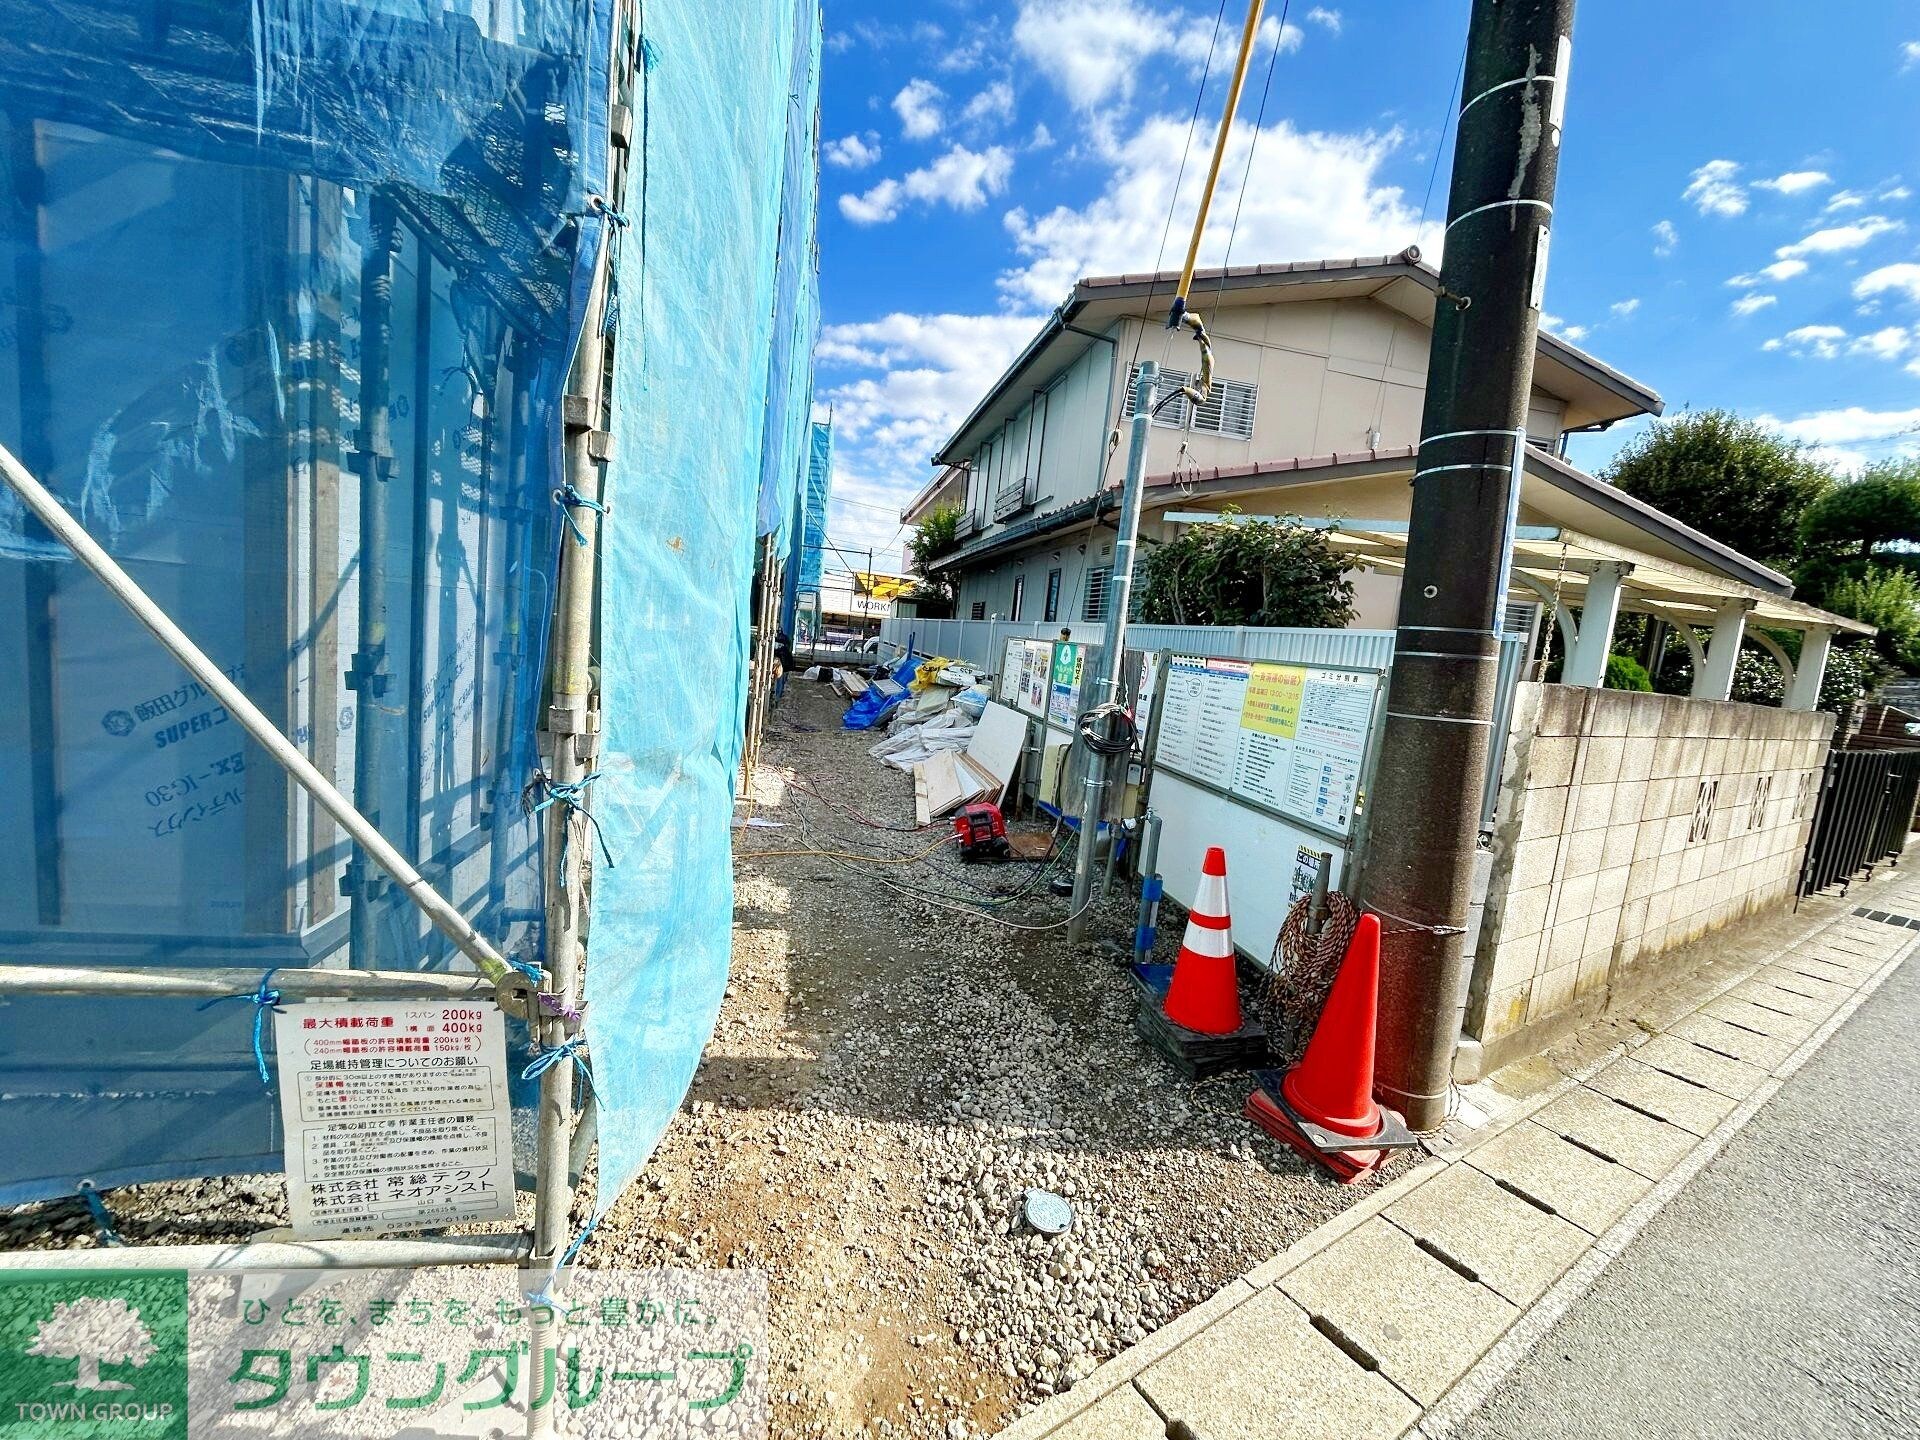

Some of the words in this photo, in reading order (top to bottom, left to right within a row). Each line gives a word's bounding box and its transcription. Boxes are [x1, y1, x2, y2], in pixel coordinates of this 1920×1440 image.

[303, 1016, 394, 1028] 最大積載荷重
[442, 1010, 482, 1020] 200kg
[442, 1022, 482, 1033] 400kg
[310, 1056, 478, 1070] 足場維持管理についてのお願い
[311, 1178, 379, 1194] 株式会社
[386, 1168, 490, 1186] 常総テクノ
[312, 1192, 380, 1207] 株式会社
[388, 1181, 494, 1200] ネオアシスト
